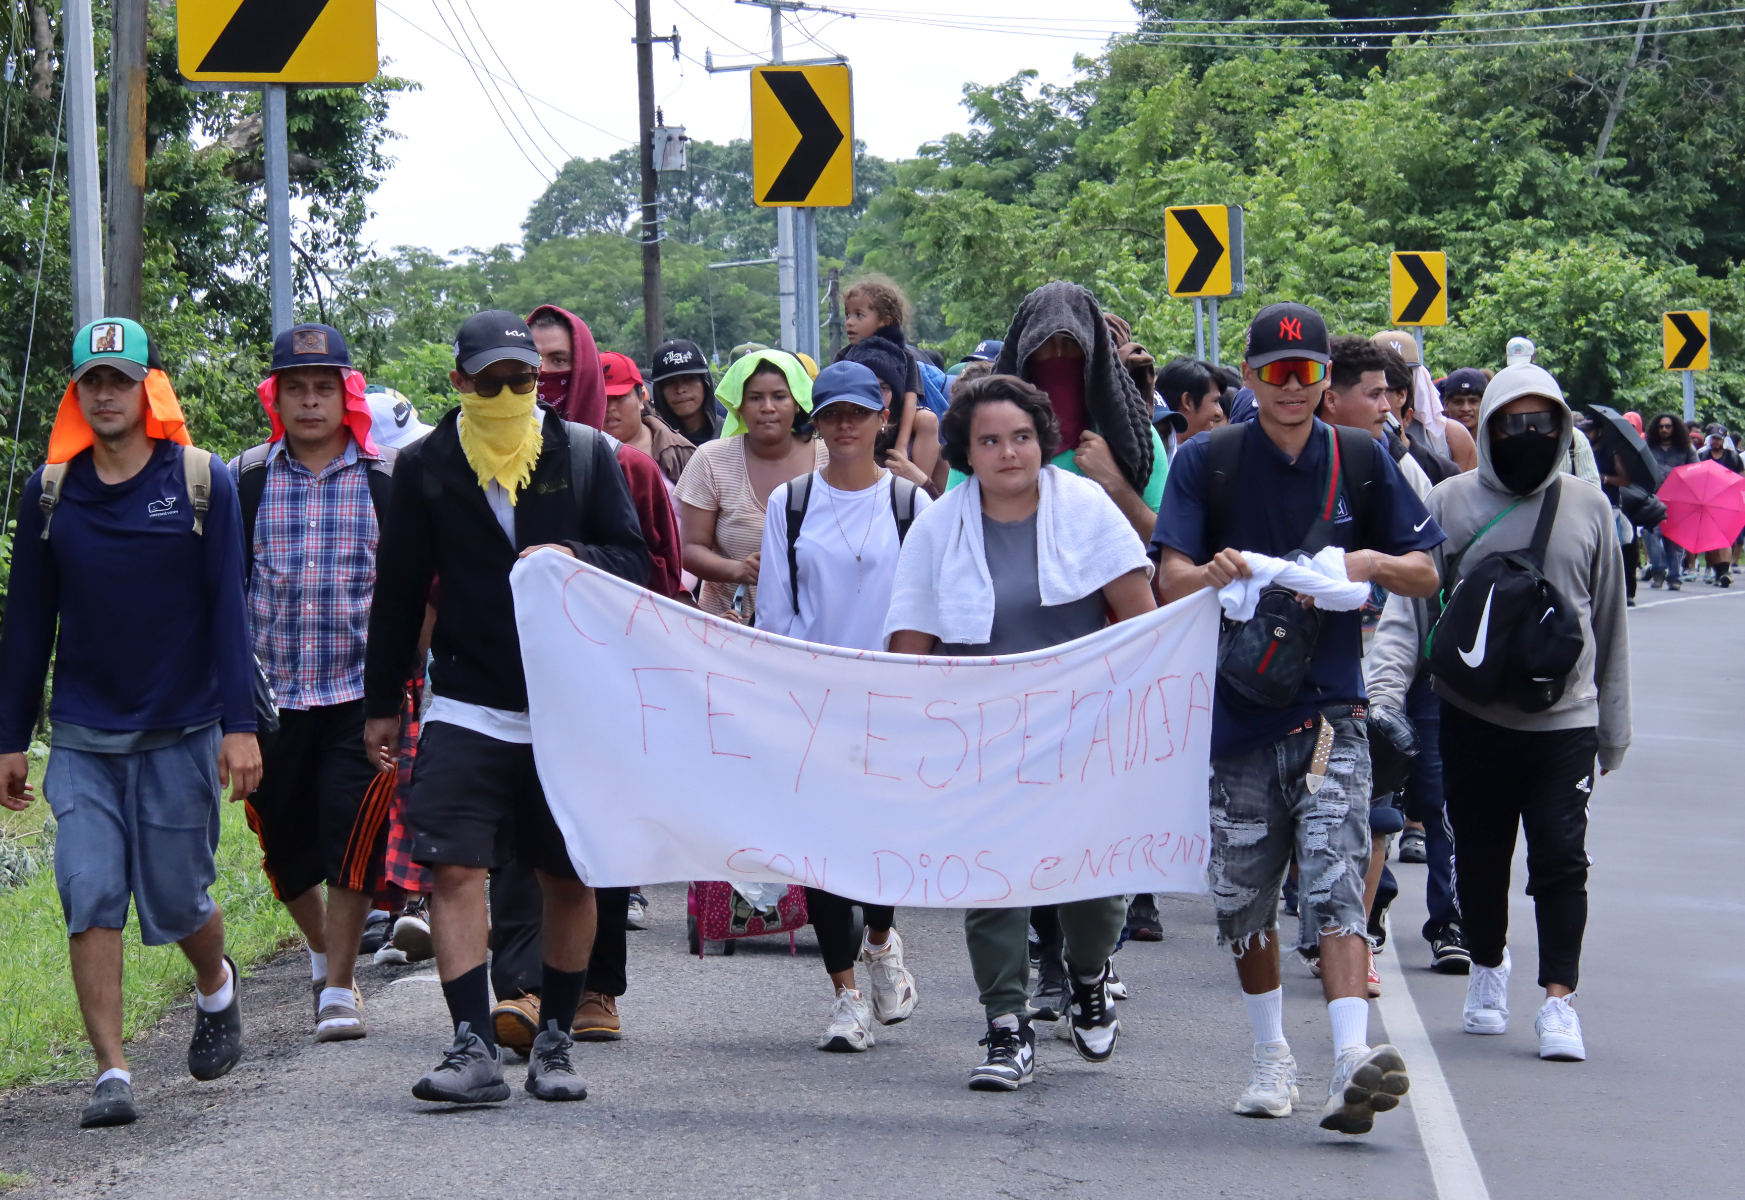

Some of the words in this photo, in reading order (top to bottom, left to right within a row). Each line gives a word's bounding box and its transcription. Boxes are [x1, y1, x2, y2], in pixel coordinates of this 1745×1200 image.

[1278, 316, 1303, 342] NY
[633, 667, 756, 760] FE
[789, 688, 831, 794] Y
[726, 847, 827, 890] CON
